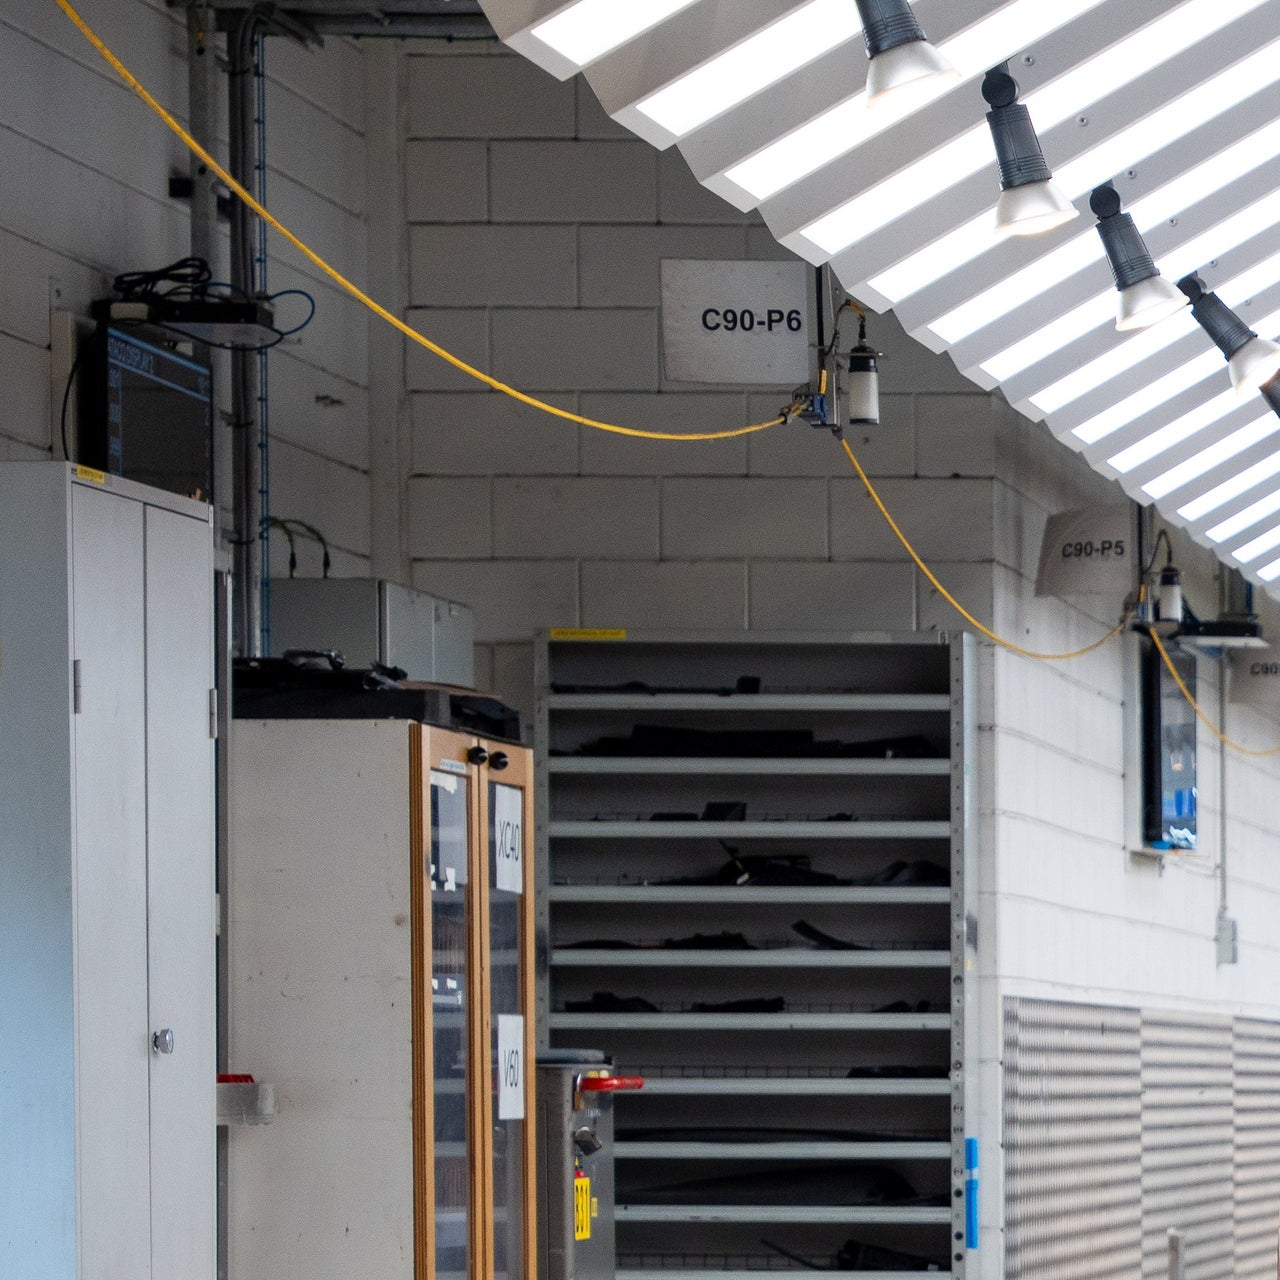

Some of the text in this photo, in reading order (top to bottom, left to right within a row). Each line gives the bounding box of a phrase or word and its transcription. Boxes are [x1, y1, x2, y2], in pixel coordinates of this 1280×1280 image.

[701, 308, 802, 331] C90-P6
[1062, 541, 1124, 558] C90-P5
[498, 819, 520, 862] XC40
[503, 1049, 520, 1088] V60
[575, 1184, 589, 1234] B31
